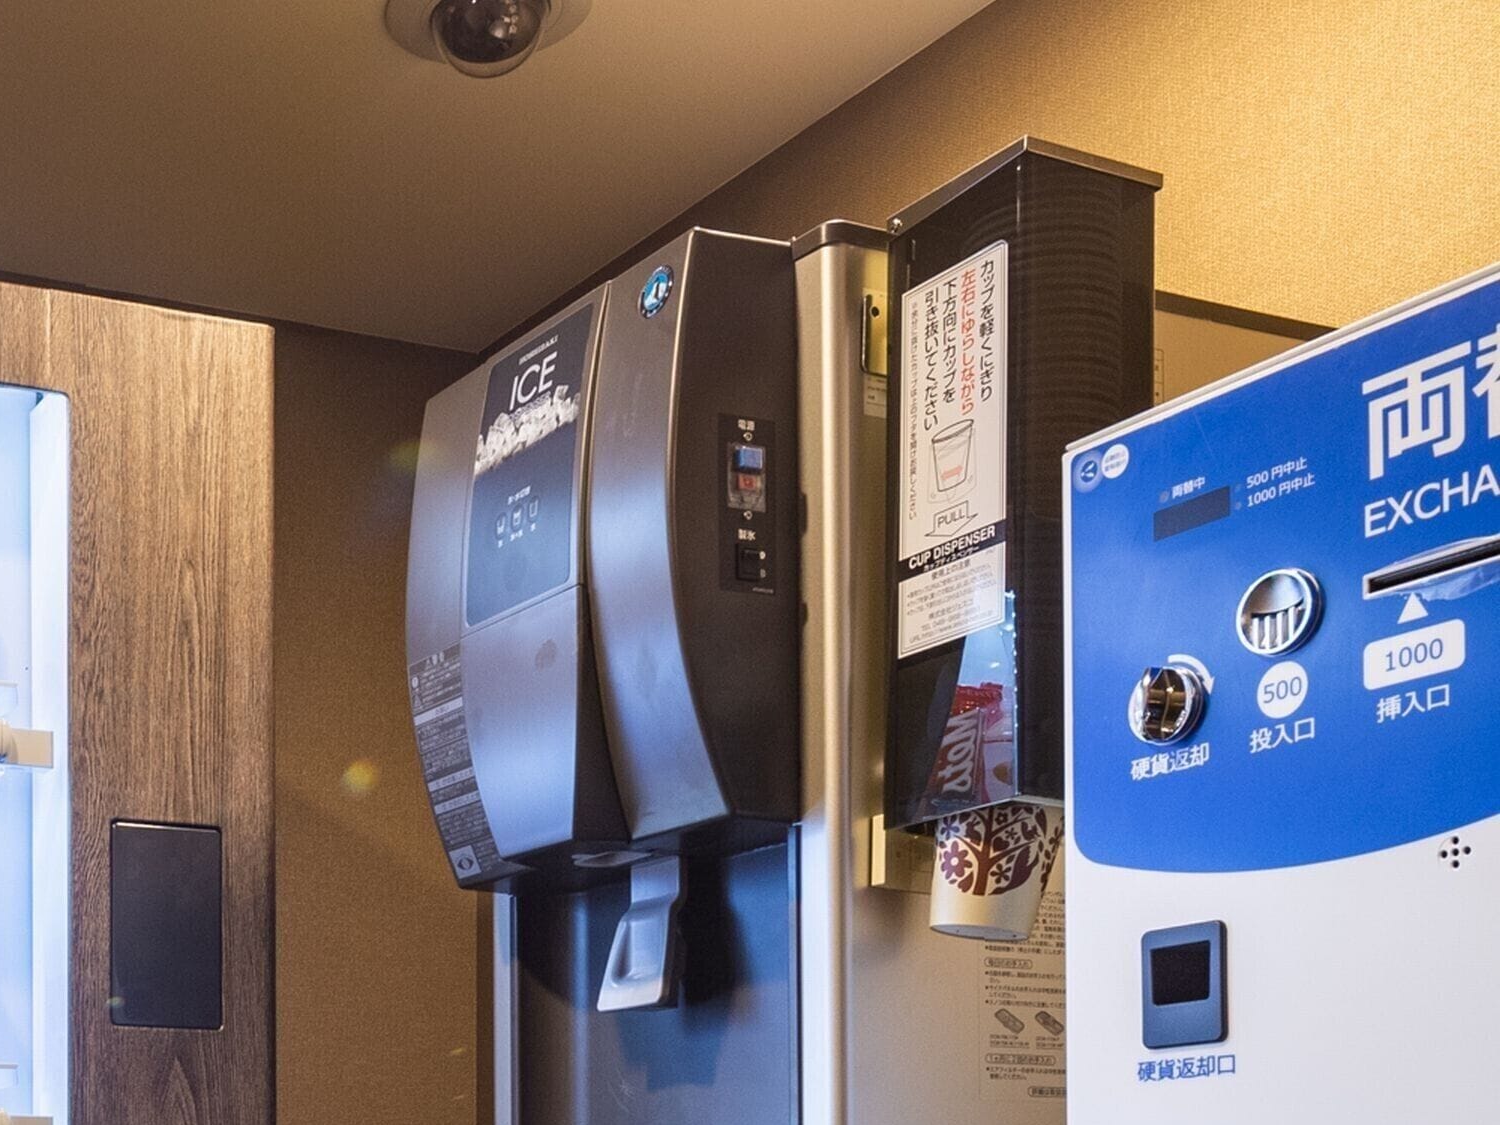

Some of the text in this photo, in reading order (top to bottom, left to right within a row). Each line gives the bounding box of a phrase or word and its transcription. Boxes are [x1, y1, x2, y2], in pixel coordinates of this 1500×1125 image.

[942, 278, 958, 403] 下方向にカップを
[960, 268, 977, 416] 左右にゆらしながら
[979, 260, 995, 401] カップを軽くにぎり
[924, 287, 939, 431] 引き抜いてください
[509, 352, 558, 410] ICE
[1246, 456, 1308, 489] 500 円中止
[1248, 472, 1316, 508] 1000 円中止
[937, 509, 966, 528] PULL
[908, 525, 995, 569] CUP DISPENSER
[1384, 638, 1443, 673] 1000
[1262, 676, 1302, 704] 500
[1376, 683, 1451, 724] 挿入口
[1249, 718, 1316, 754] 投入口
[1130, 743, 1210, 781] 硬貨返却
[1137, 1054, 1237, 1083] 硬貨返却口
